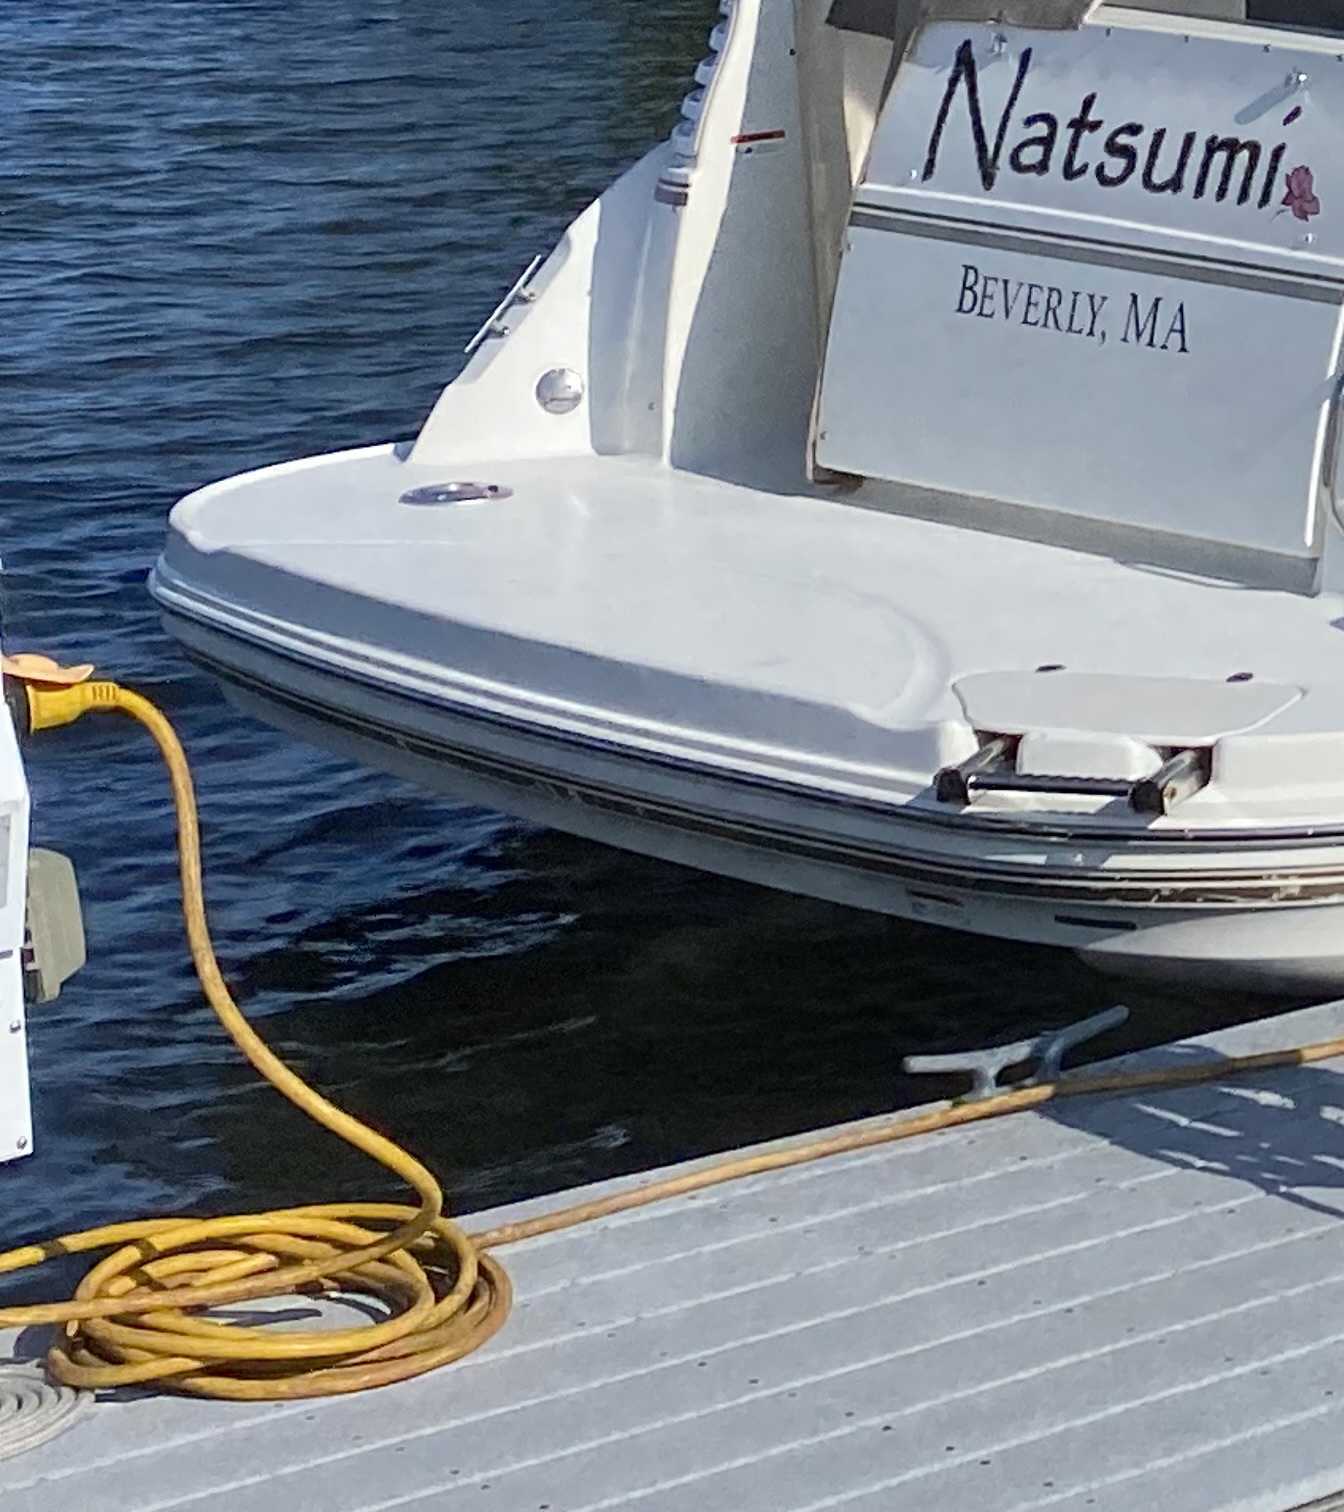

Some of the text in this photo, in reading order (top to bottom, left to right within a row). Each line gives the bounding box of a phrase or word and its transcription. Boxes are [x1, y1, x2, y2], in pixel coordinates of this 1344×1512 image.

[921, 38, 1303, 209] Natsumi
[955, 264, 1191, 354] BEVERLY, MA
